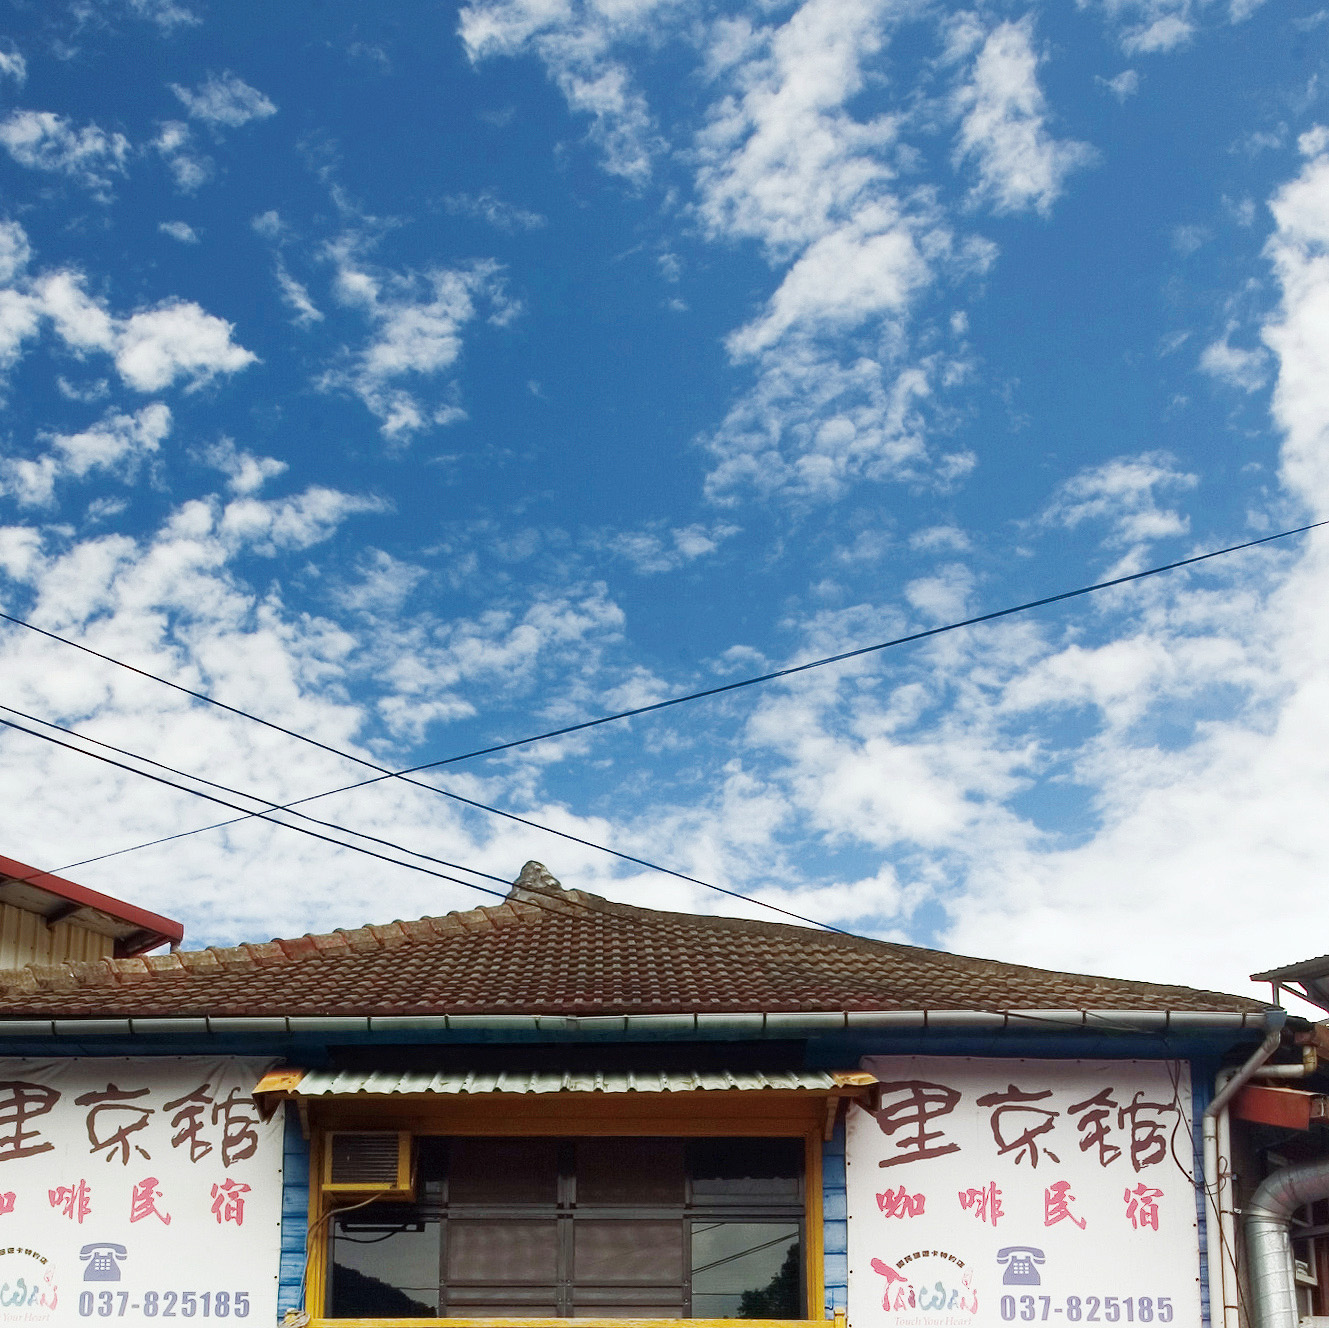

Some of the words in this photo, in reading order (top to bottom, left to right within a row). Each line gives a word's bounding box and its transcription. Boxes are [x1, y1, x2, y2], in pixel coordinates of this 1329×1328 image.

[876, 1181, 1164, 1231] 咖啡民宿
[78, 1290, 250, 1318] 037-825185
[1000, 1295, 1174, 1322] 037-825185
